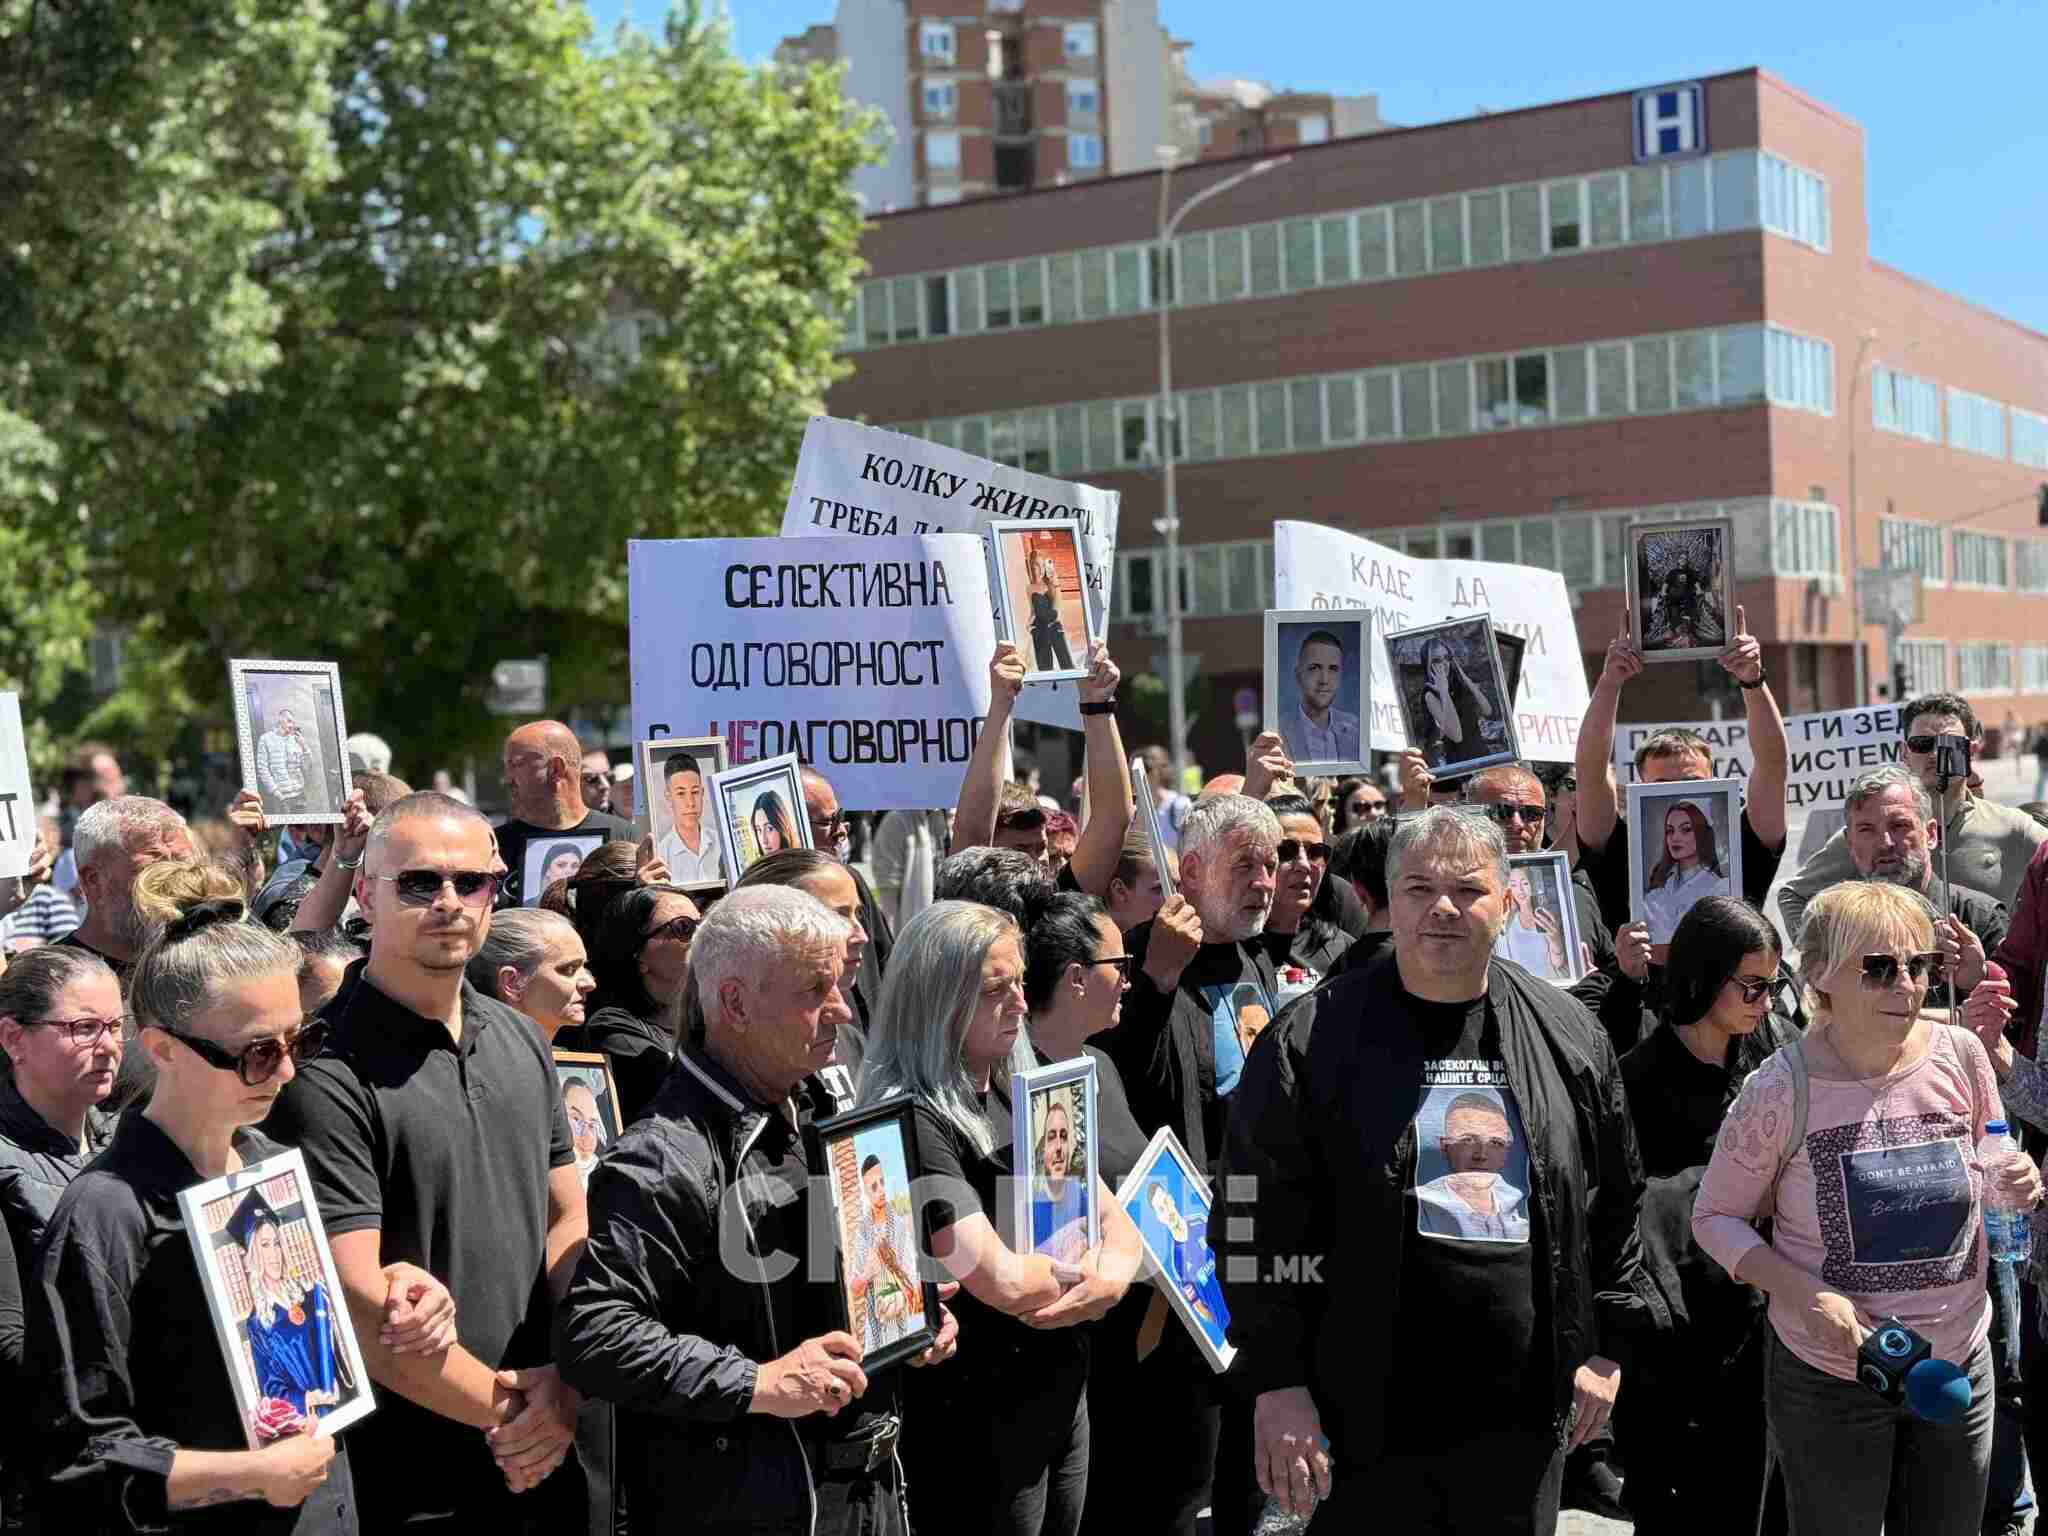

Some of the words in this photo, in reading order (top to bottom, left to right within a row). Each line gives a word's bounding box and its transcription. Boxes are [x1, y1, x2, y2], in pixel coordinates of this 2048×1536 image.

[1644, 91, 1694, 156] H
[860, 453, 968, 499] КОЛКУ
[810, 497, 897, 536] ТРЕБА
[725, 559, 953, 609] СЕЛЕКТИВНА
[1351, 552, 1413, 602] КАДЕ
[1452, 576, 1491, 608] ДА
[691, 640, 944, 692] ОДГОВОРНОСТ
[1804, 715, 1844, 741] ГИ
[1791, 740, 1905, 773] ИСТЕМ
[1423, 1059, 1489, 1071] ЗАСЕКОГАШ
[1425, 1072, 1474, 1084] НАШИТЕ
[1898, 1166, 1913, 1177] BE
[1916, 1160, 1957, 1175] AFRAID
